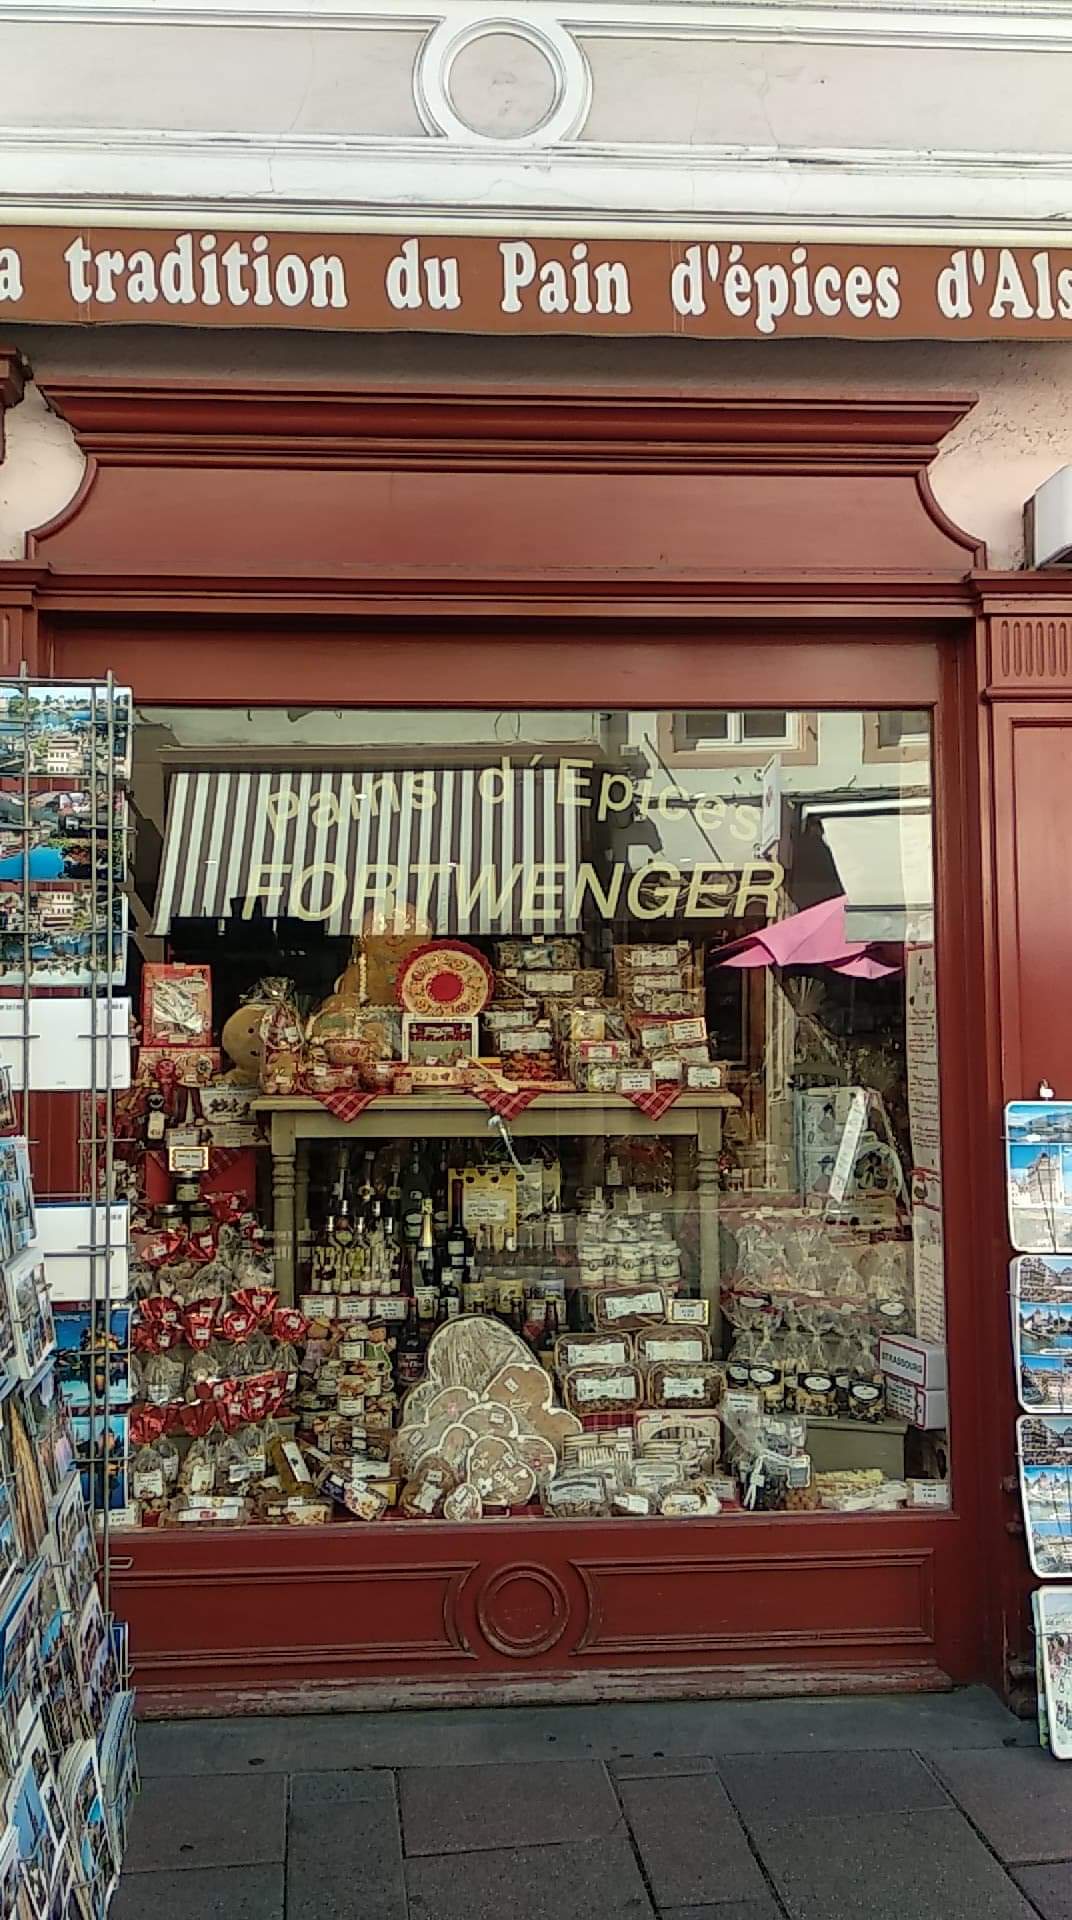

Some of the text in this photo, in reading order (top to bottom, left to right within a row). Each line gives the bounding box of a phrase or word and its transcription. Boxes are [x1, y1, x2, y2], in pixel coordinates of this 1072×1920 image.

[0, 246, 23, 301] a
[63, 232, 349, 308] tradition
[385, 238, 461, 310] du
[499, 240, 632, 314] Pain
[672, 243, 901, 334] d'épices
[241, 861, 786, 921] FORTWENGER
